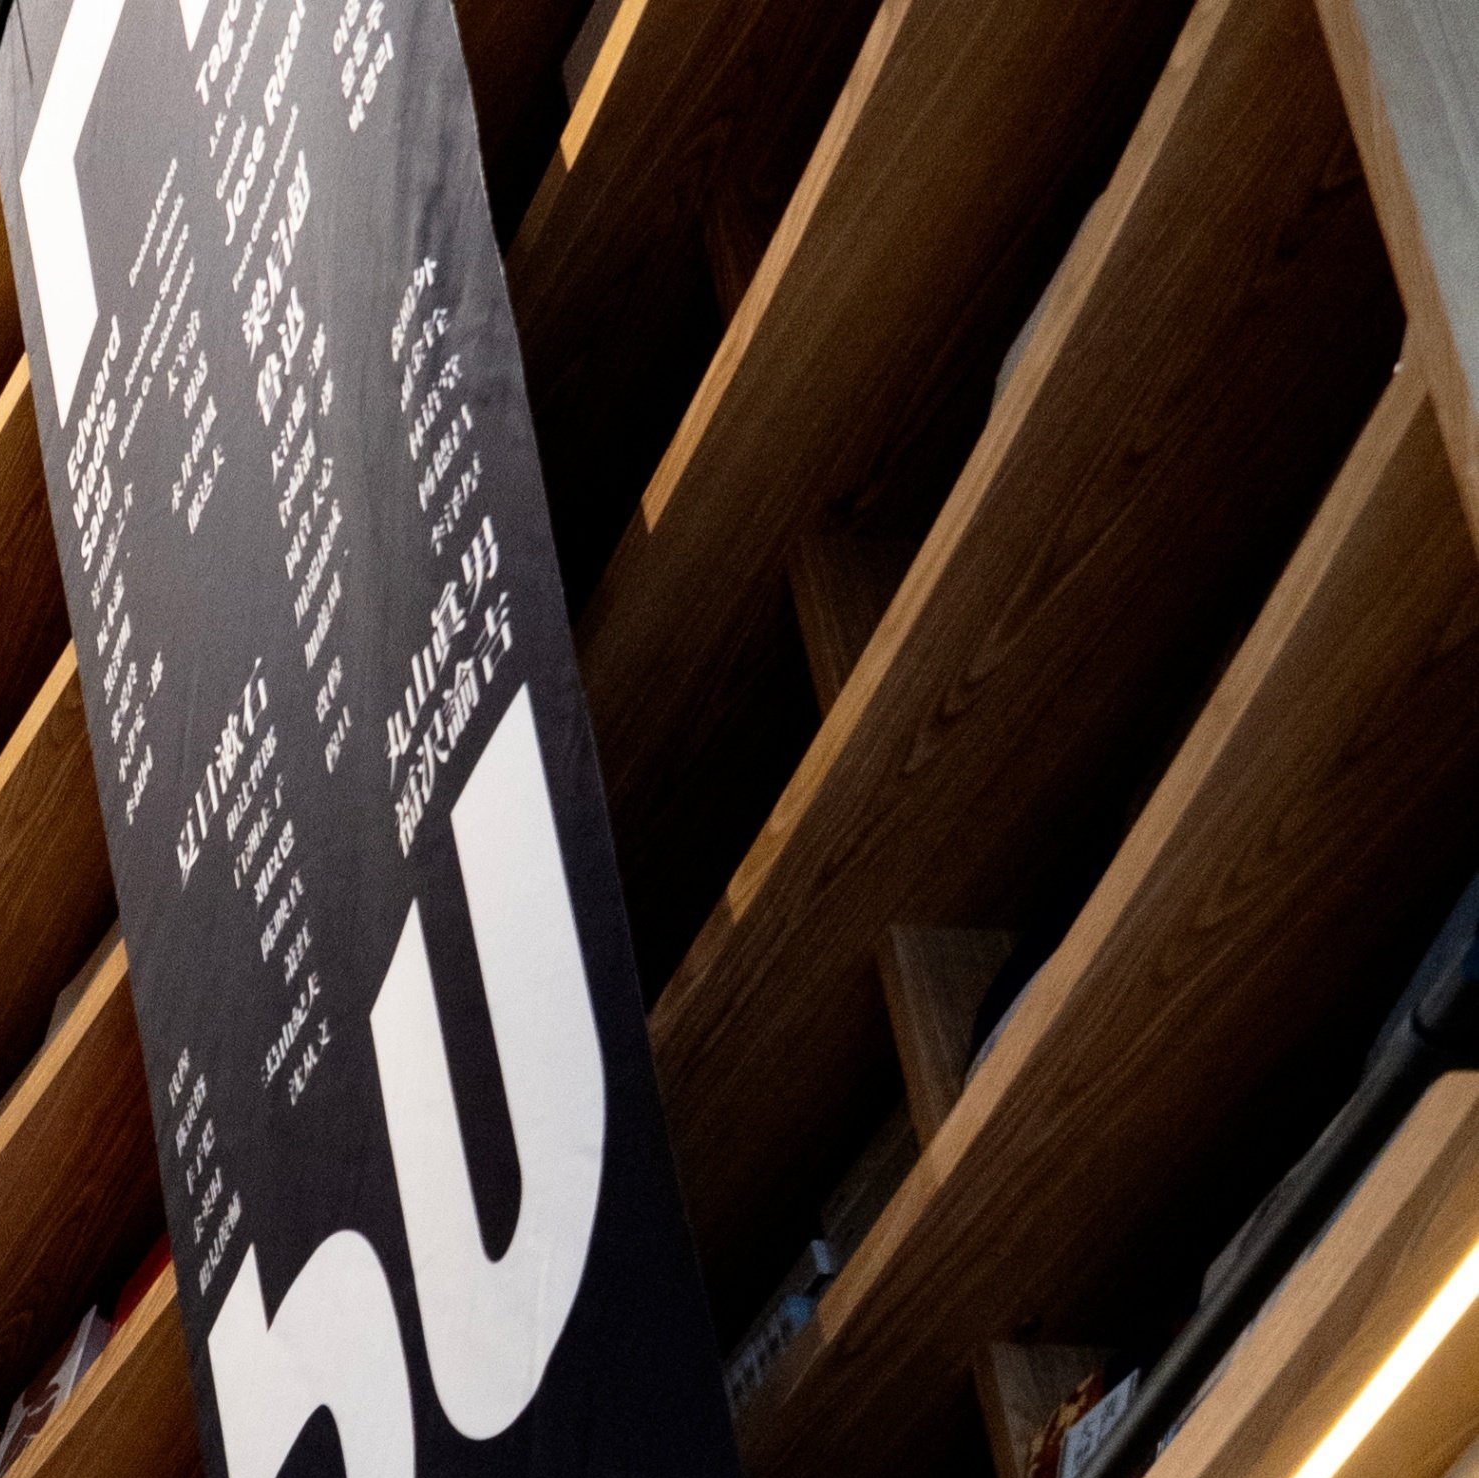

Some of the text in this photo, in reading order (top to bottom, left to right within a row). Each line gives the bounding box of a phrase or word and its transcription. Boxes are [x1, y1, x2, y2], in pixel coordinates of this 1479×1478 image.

[216, 115, 247, 199] Gandhi
[225, 125, 264, 246] Jose
[124, 224, 189, 397] Jonathan Spence
[130, 207, 159, 287] Donald
[66, 315, 121, 487] Edward
[255, 287, 307, 426] 鲁迅
[72, 398, 117, 528] Wadie
[119, 401, 143, 460] Edwin
[81, 467, 112, 573] Said
[294, 500, 343, 627] 川端康成
[175, 656, 268, 891] 夏目漱石
